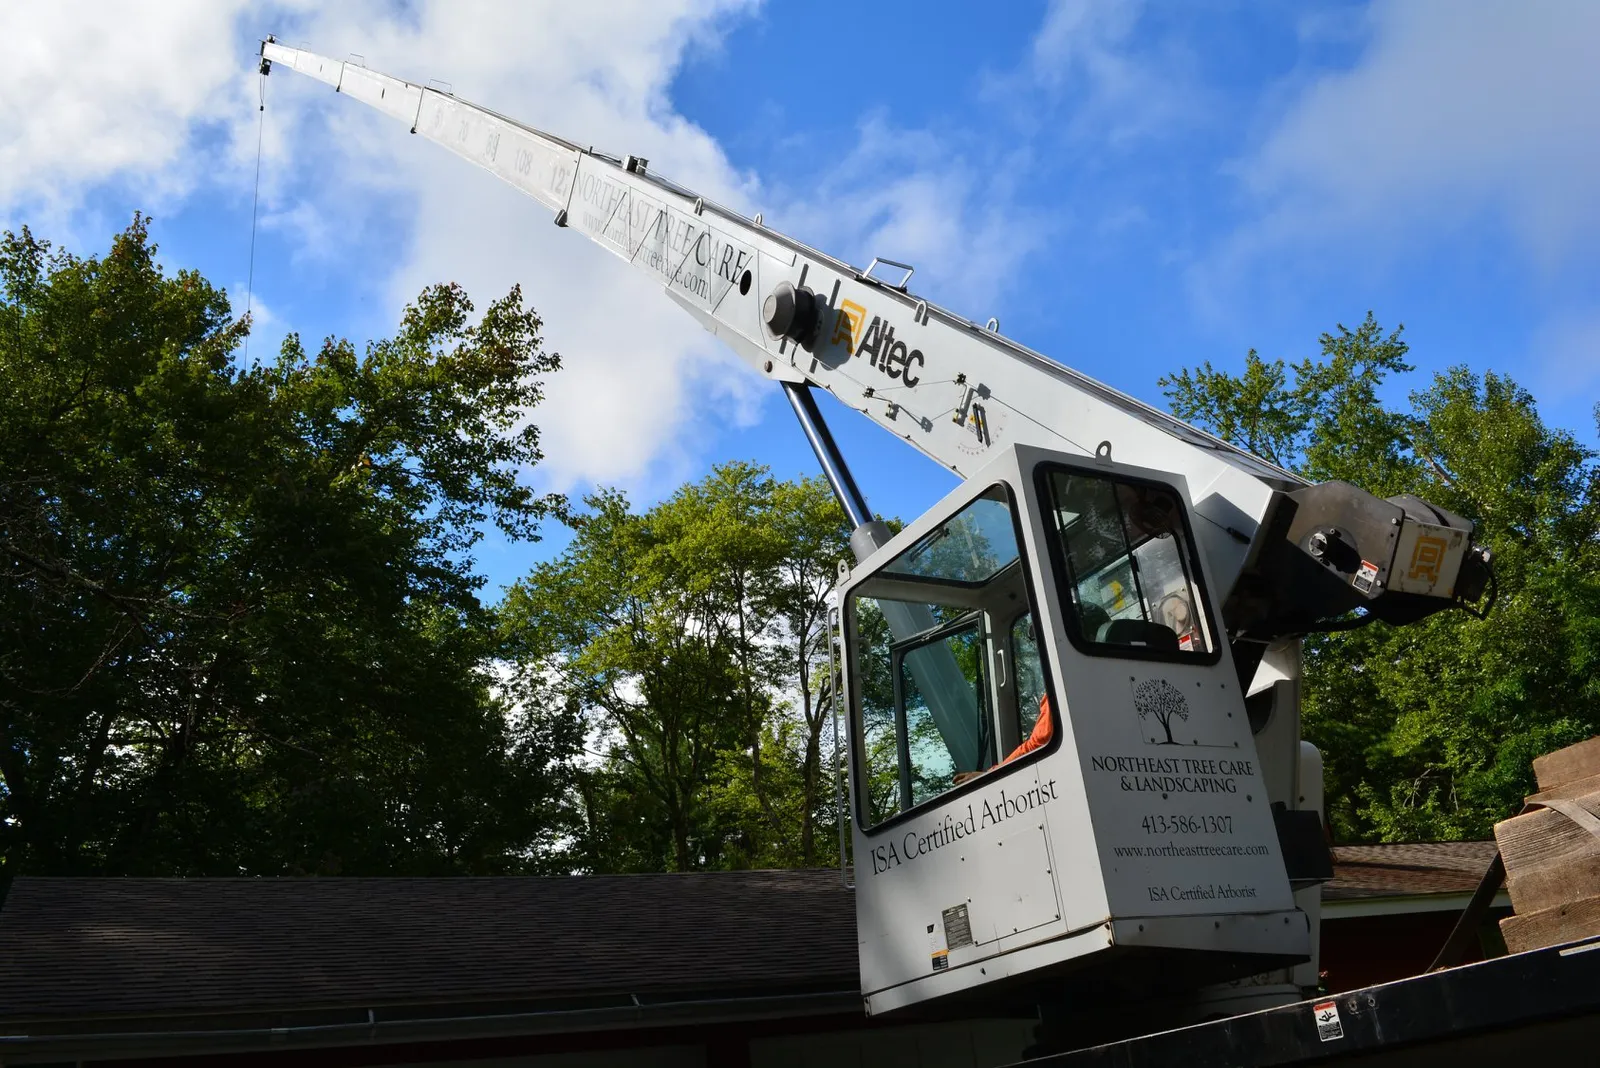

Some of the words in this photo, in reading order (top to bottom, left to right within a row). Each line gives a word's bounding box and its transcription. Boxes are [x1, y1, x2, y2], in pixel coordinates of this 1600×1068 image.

[514, 147, 533, 176] 108
[573, 169, 654, 233] NORTHEAST
[656, 207, 695, 256] TREE
[695, 230, 747, 286] CARE
[855, 315, 924, 388] Altec
[1091, 755, 1180, 774] NORTHEAST
[1181, 758, 1217, 775] TREE
[1218, 760, 1254, 776] CARE
[1120, 775, 1133, 792] &
[1136, 776, 1237, 793] LANDSCAPING
[871, 841, 901, 876] ISA
[903, 804, 976, 860] Certified
[980, 778, 1059, 830] Arborist
[1142, 815, 1233, 834] 413-586-1307
[1148, 887, 1170, 901] ISA
[1170, 885, 1215, 900] Certified
[1216, 884, 1257, 898] Arborist
